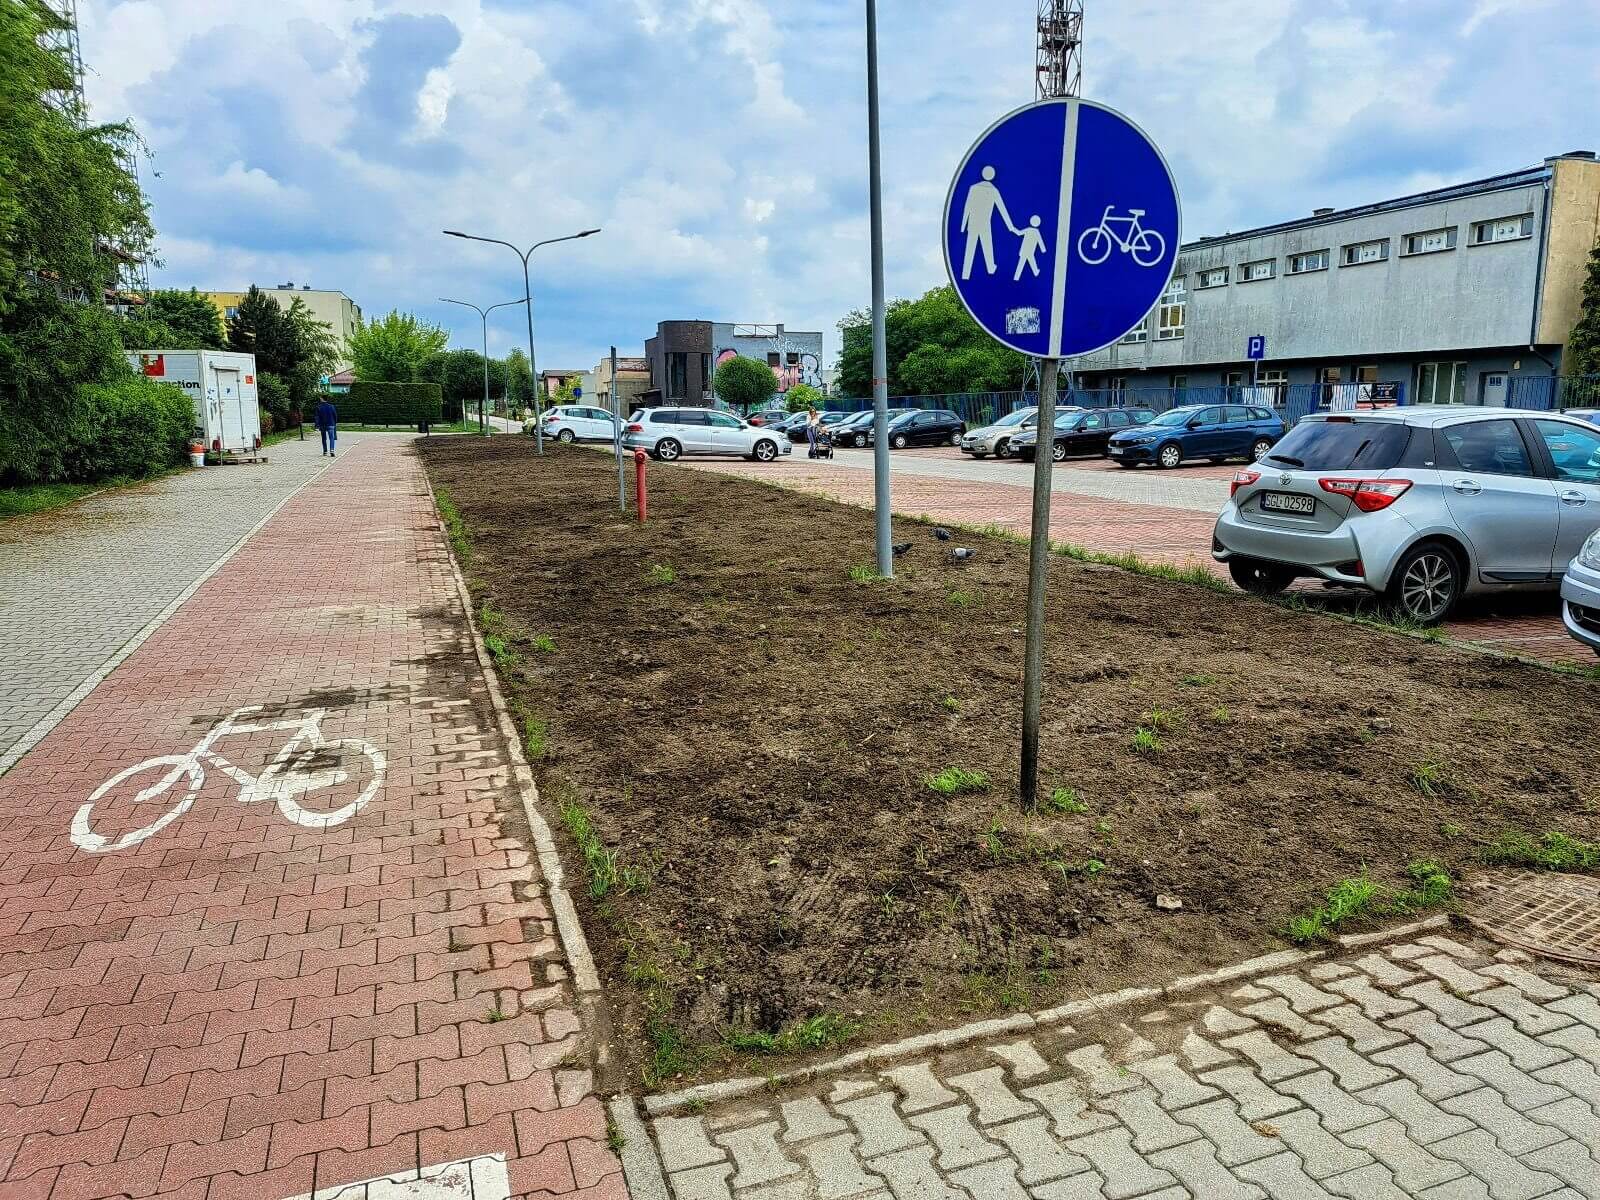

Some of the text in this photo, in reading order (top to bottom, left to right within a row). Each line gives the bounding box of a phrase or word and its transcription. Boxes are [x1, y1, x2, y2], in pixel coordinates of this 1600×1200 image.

[1251, 339, 1260, 356] P
[1265, 494, 1313, 511] SGL 02598
